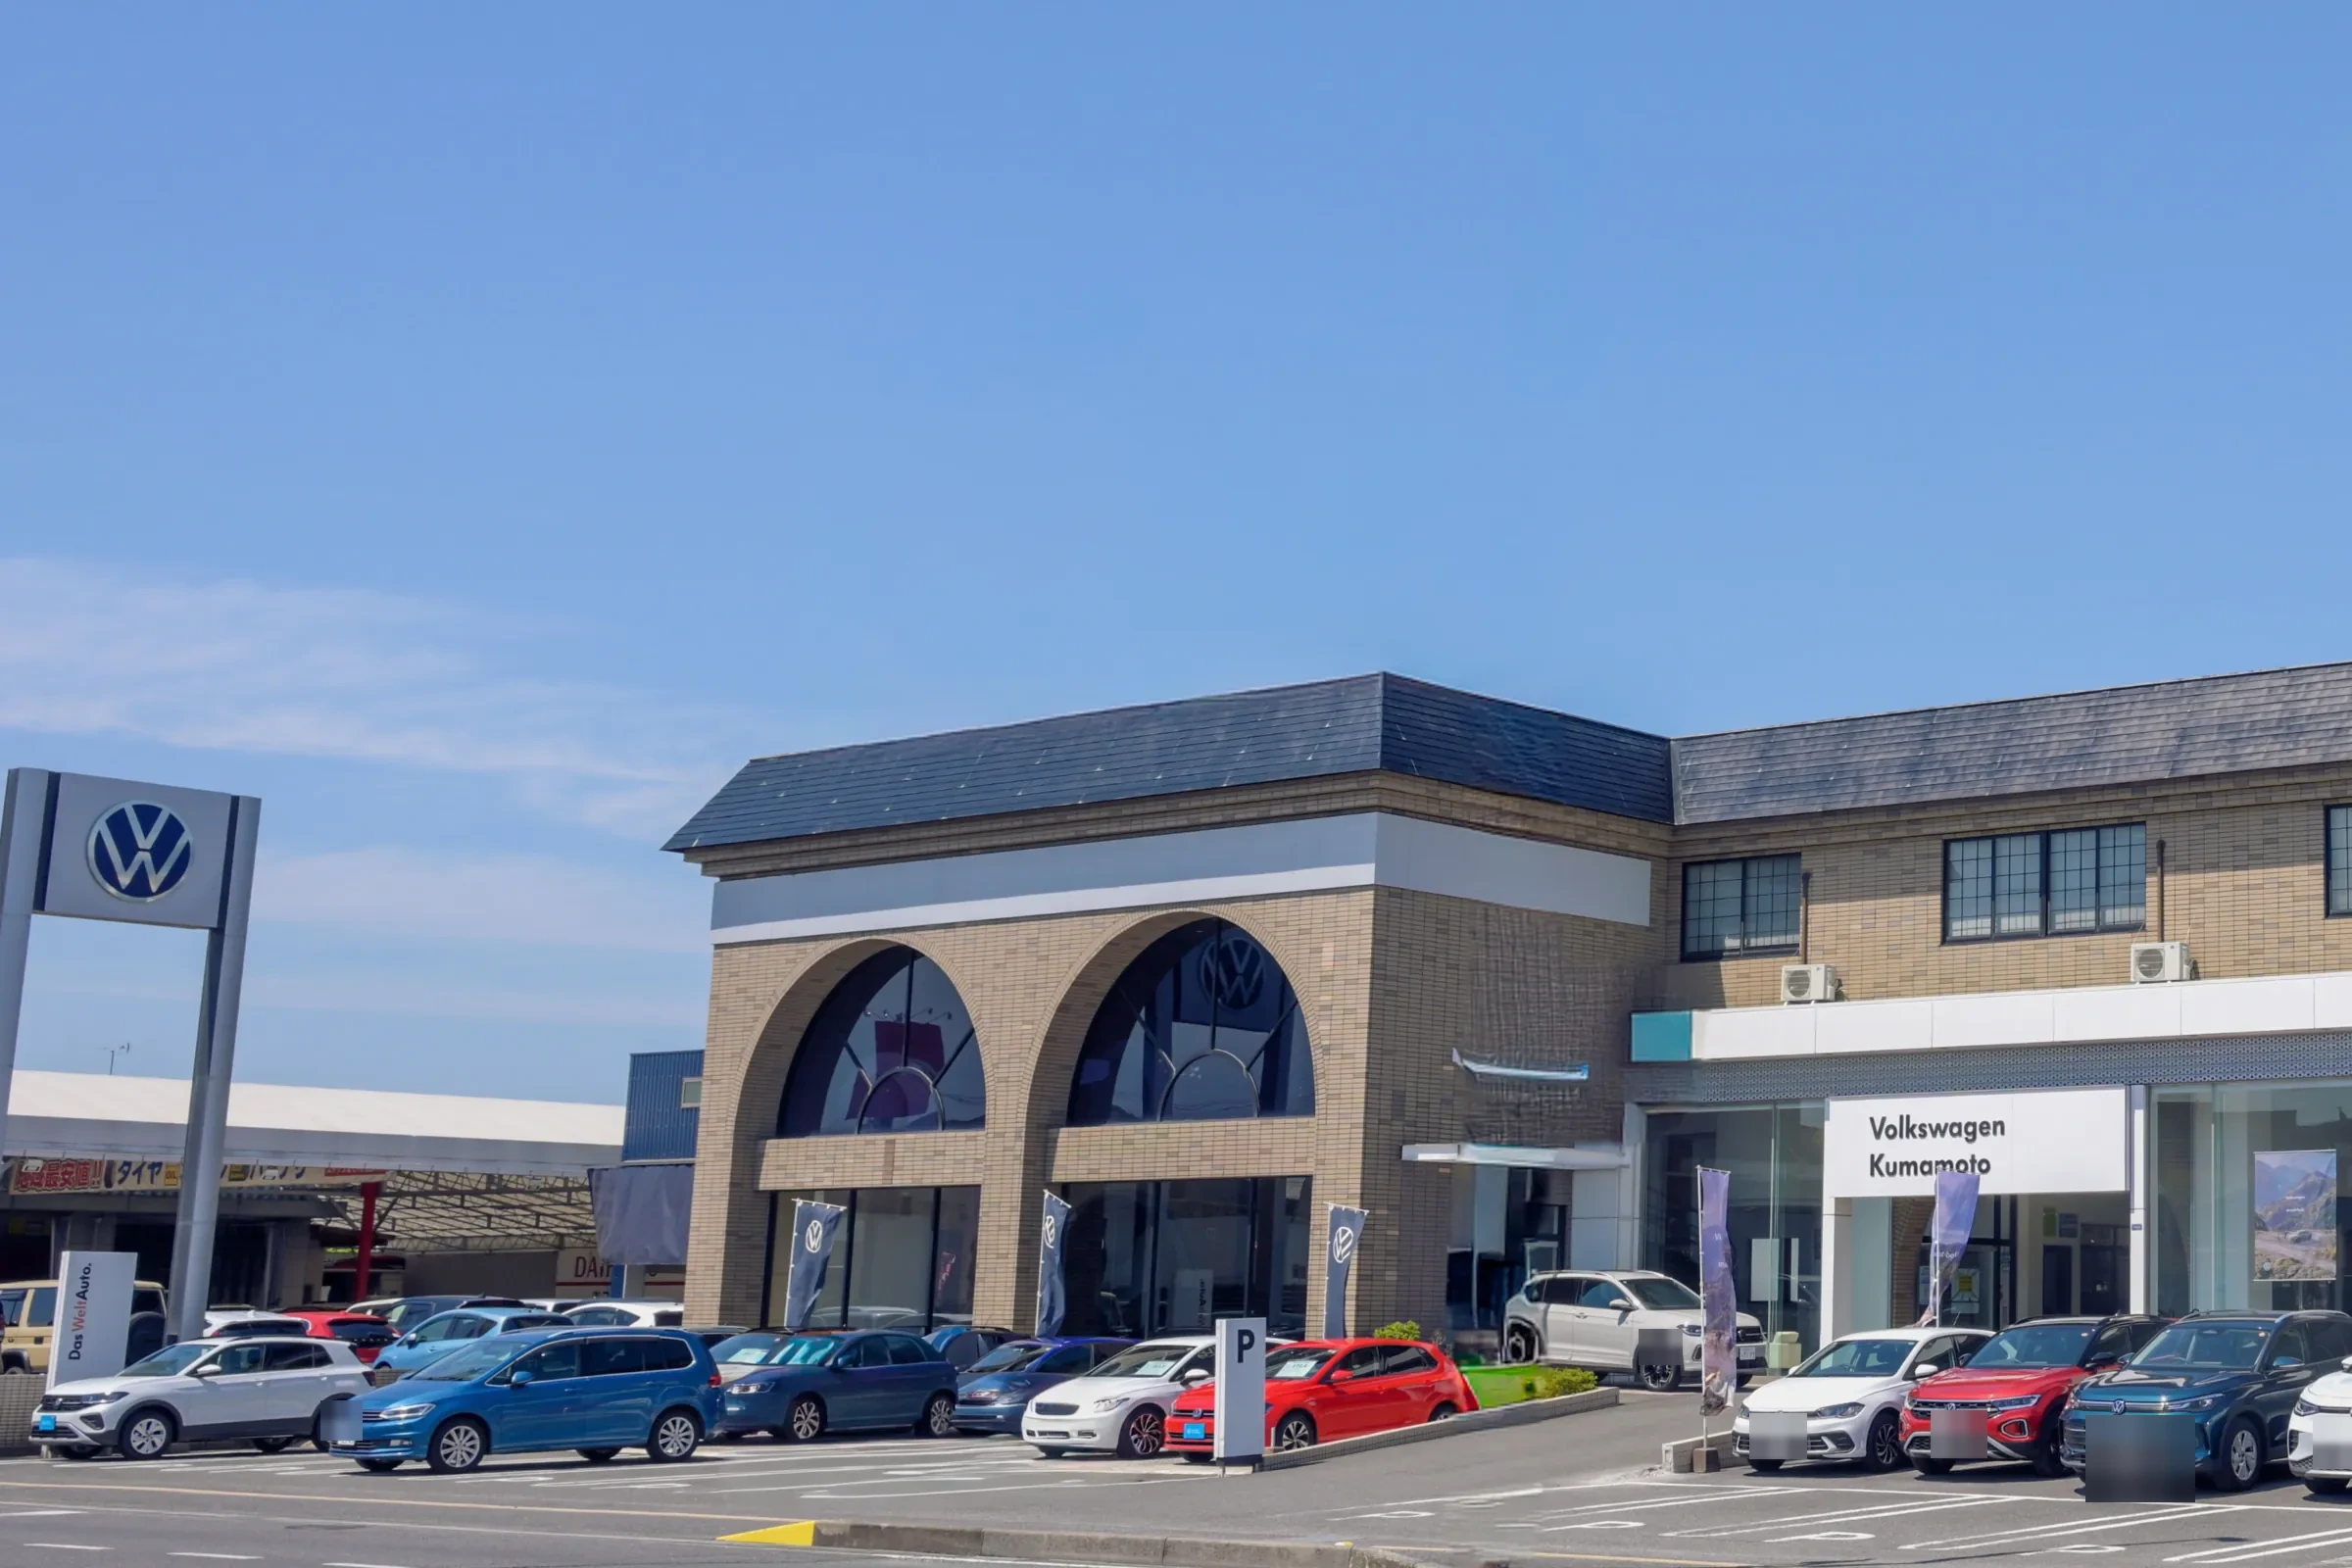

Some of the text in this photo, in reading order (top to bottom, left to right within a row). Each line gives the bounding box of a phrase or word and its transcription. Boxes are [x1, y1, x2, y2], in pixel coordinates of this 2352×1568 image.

[1869, 1114, 2005, 1144] Volkswagen
[118, 1160, 163, 1185] タイヤ
[68, 1334, 83, 1360] Das
[1238, 1329, 1255, 1363] P
